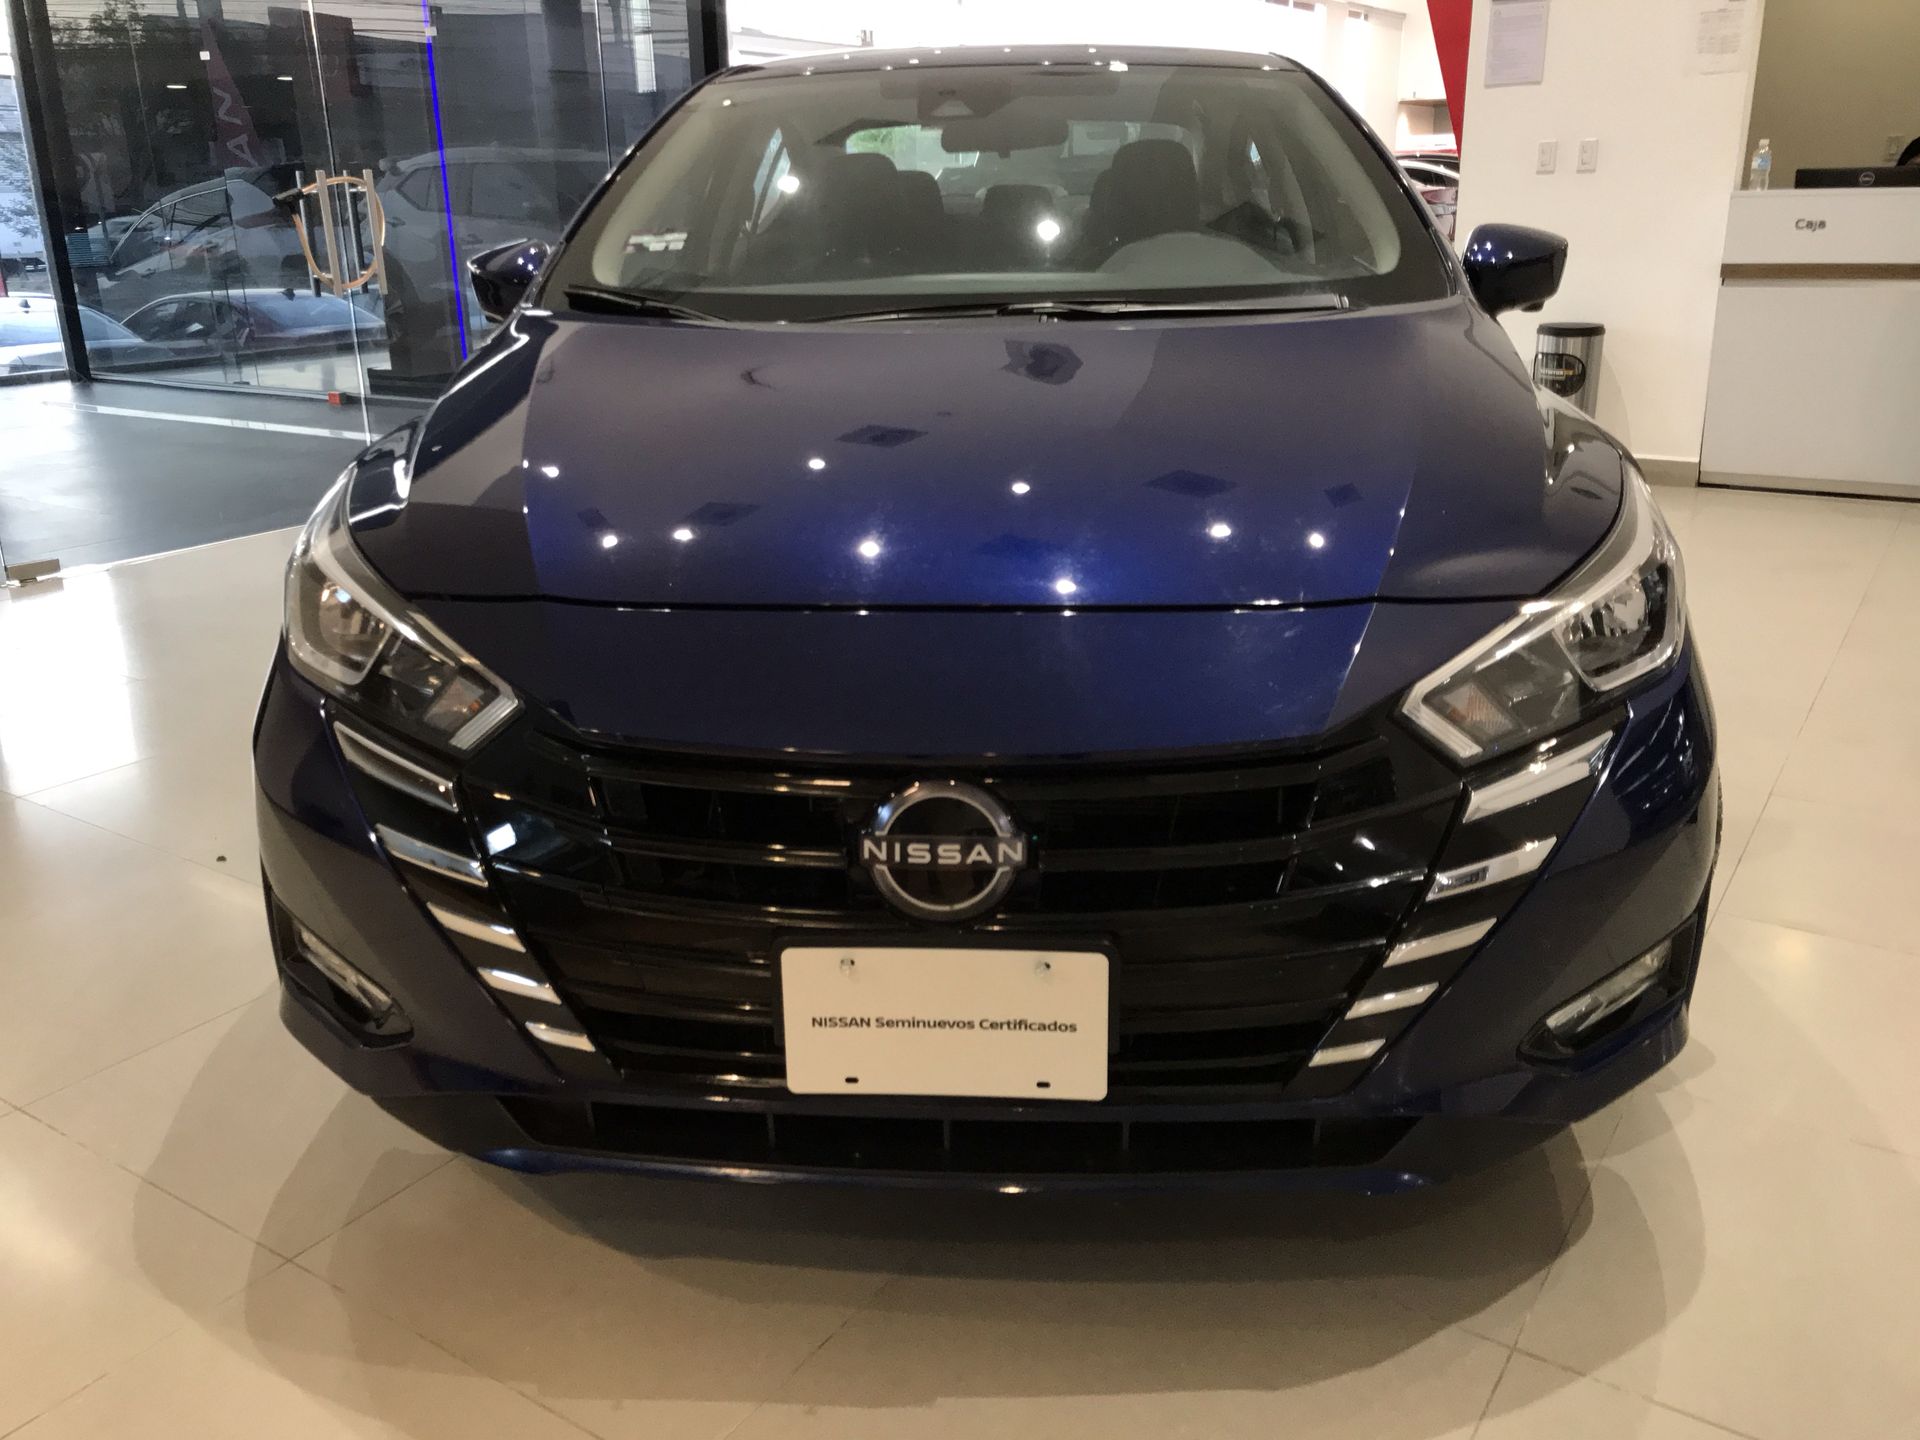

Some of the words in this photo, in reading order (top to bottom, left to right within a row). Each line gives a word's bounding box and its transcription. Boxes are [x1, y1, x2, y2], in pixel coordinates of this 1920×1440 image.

[1795, 218, 1826, 231] Caja
[863, 838, 1023, 864] NISSAN
[811, 1016, 871, 1028] NISSAN
[875, 1016, 975, 1030] Seminuevos
[979, 1018, 1077, 1033] Certificados
